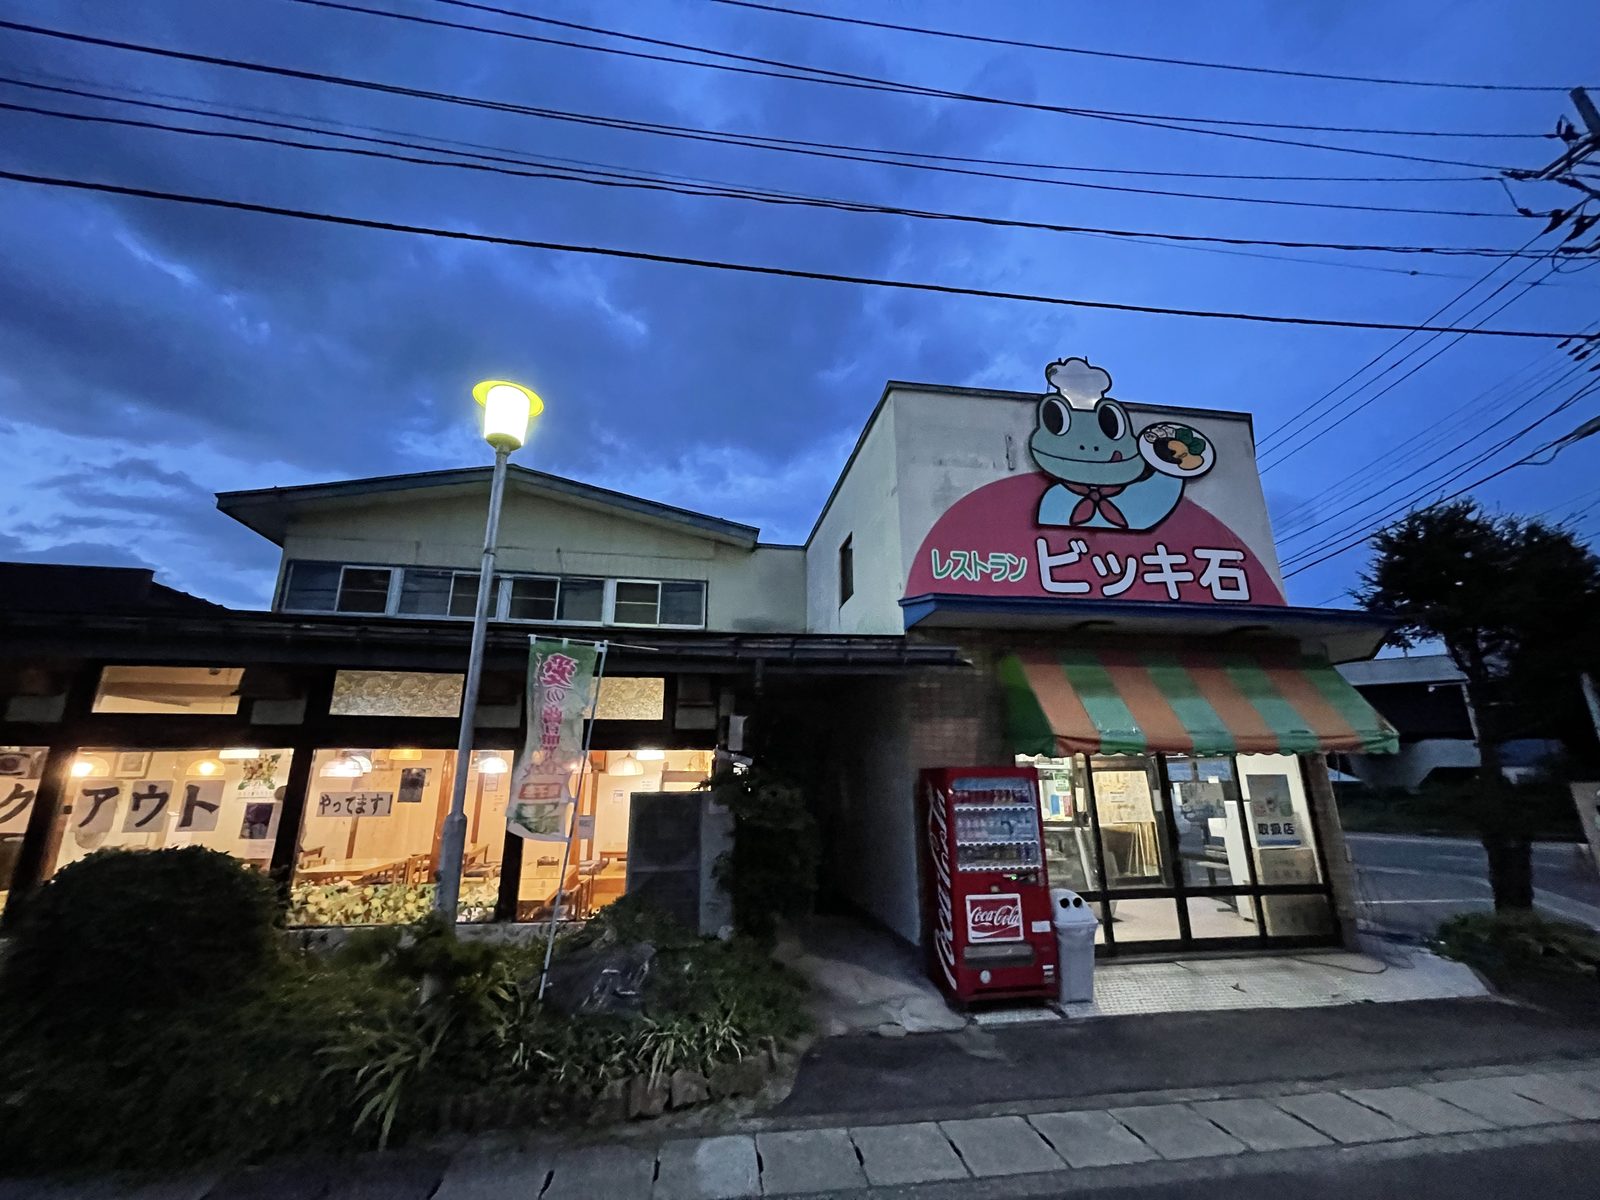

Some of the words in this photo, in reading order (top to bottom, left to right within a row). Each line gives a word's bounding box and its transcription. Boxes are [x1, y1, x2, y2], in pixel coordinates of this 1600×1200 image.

[931, 549, 1027, 581] レストラン
[970, 904, 1020, 927] Coca-Cola
